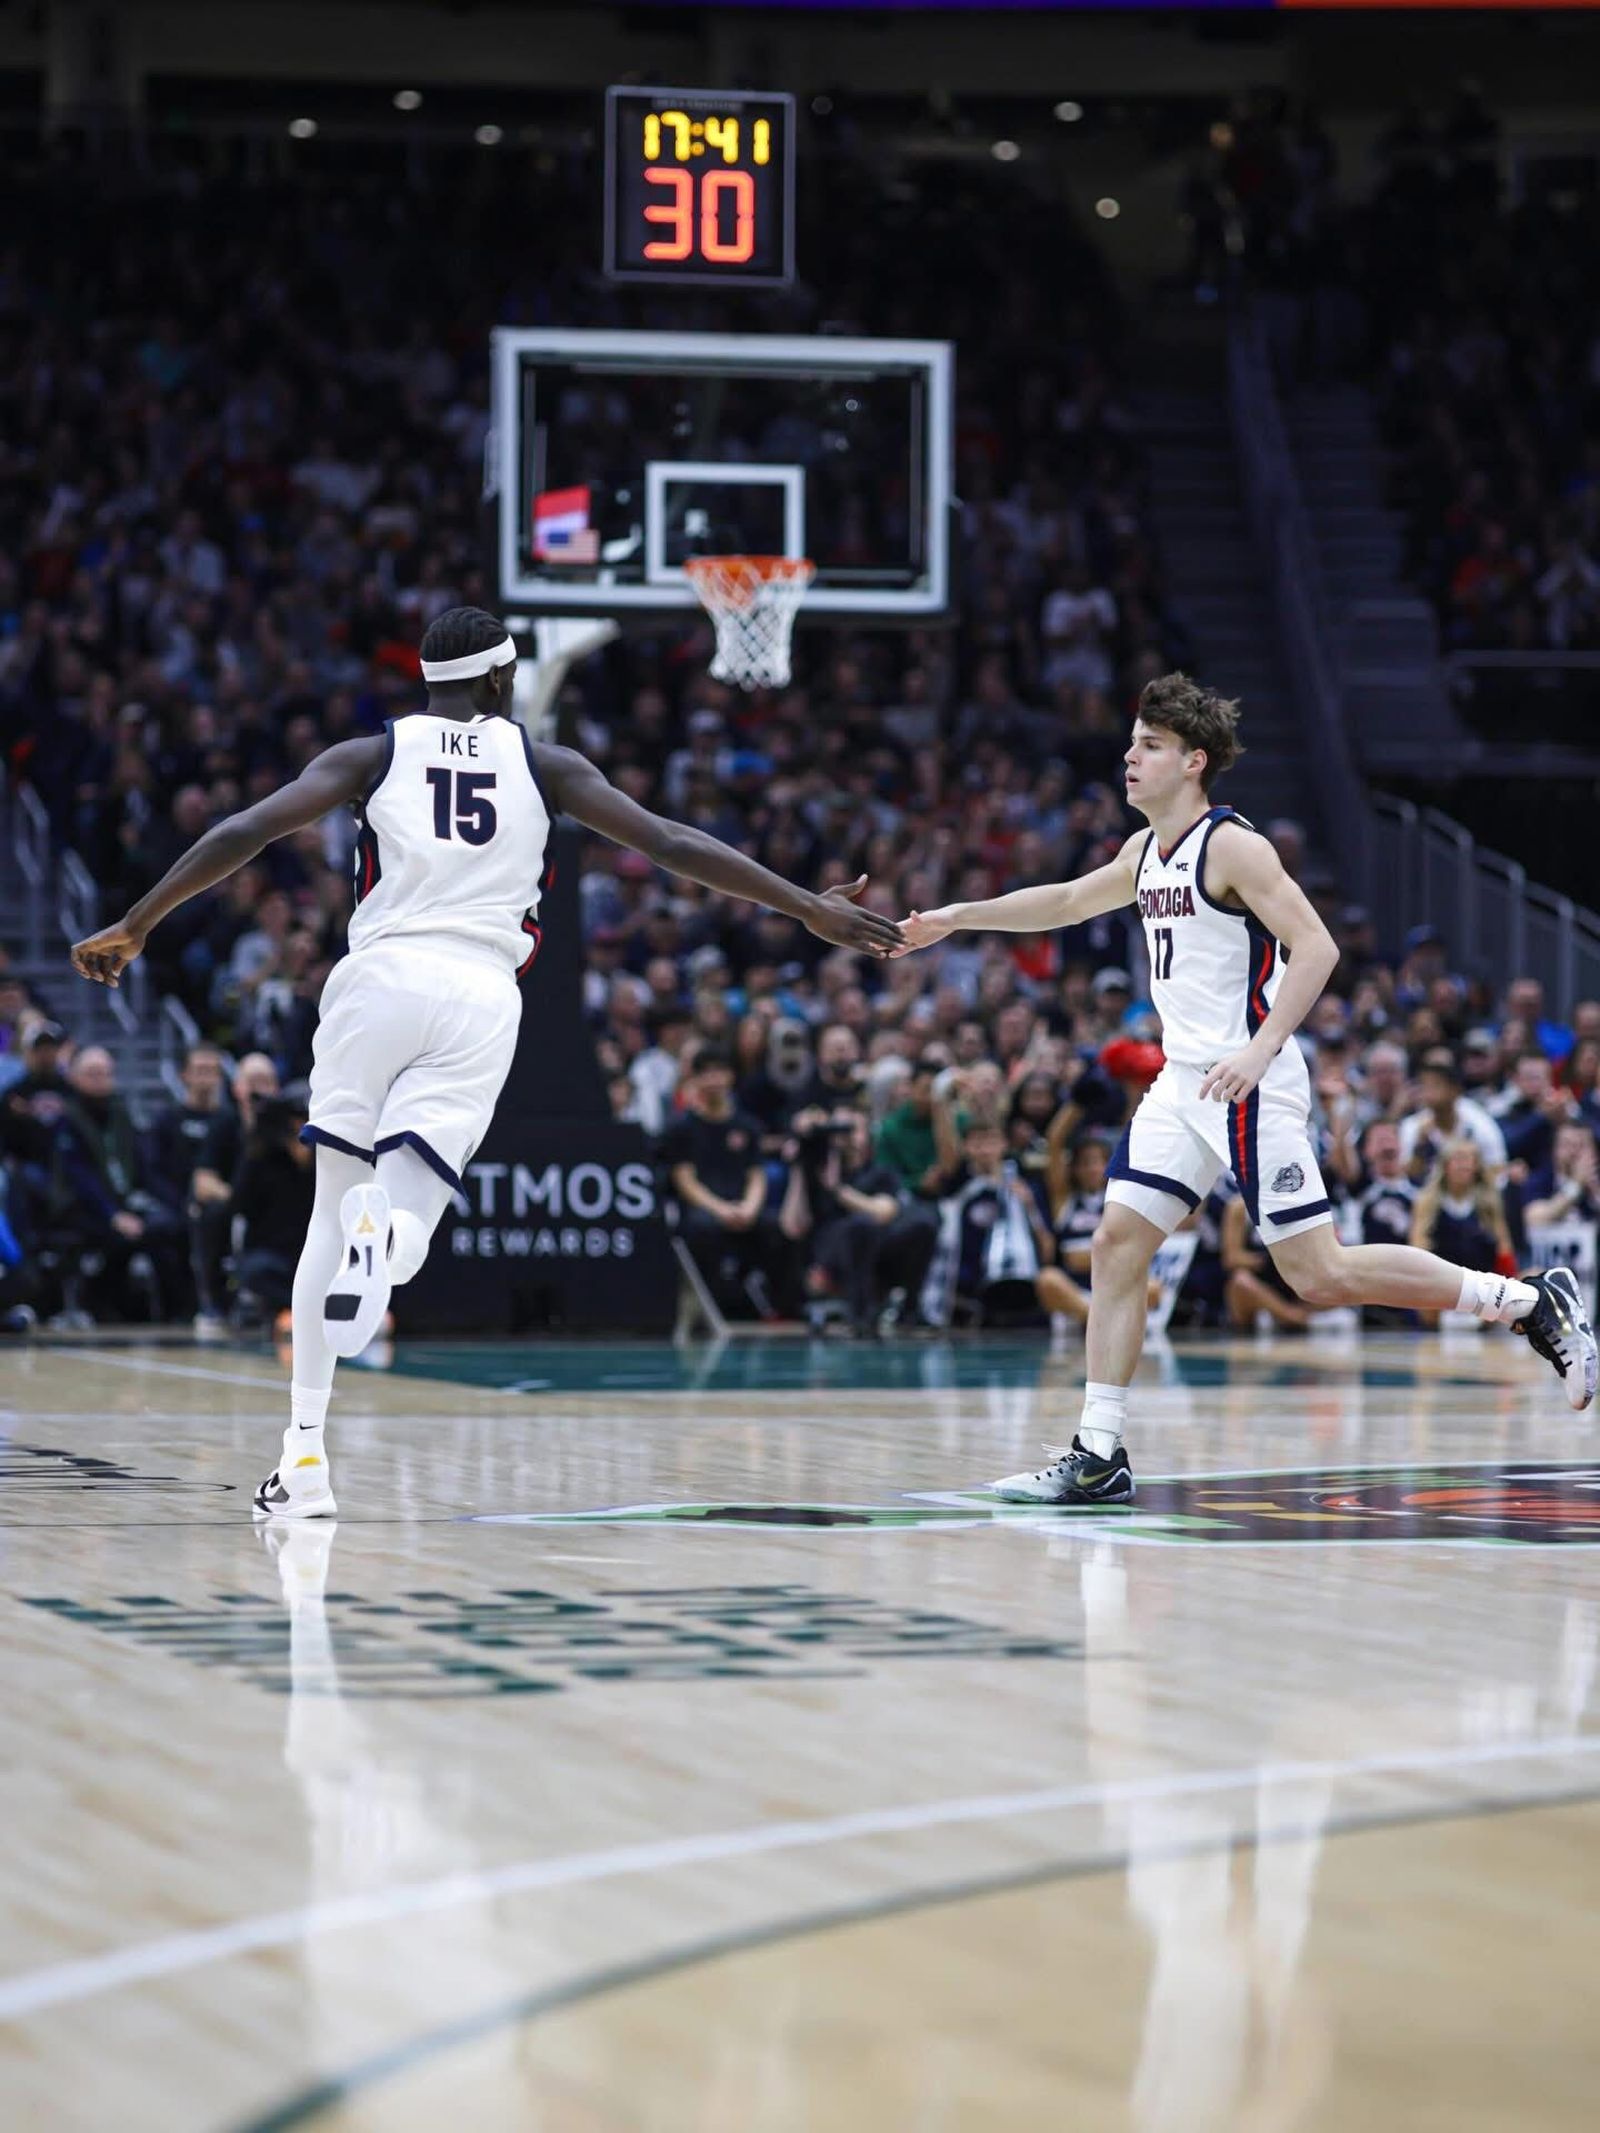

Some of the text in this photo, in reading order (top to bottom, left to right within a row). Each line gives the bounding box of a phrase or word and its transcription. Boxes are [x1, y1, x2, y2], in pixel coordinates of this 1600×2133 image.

[644, 111, 770, 165] 17:41
[643, 167, 754, 263] 30
[441, 732, 479, 758] IKE
[426, 767, 497, 846] 15
[1139, 886, 1196, 919] GONZAGA
[1154, 927, 1174, 980] 17
[451, 1226, 635, 1258] REWARDS
